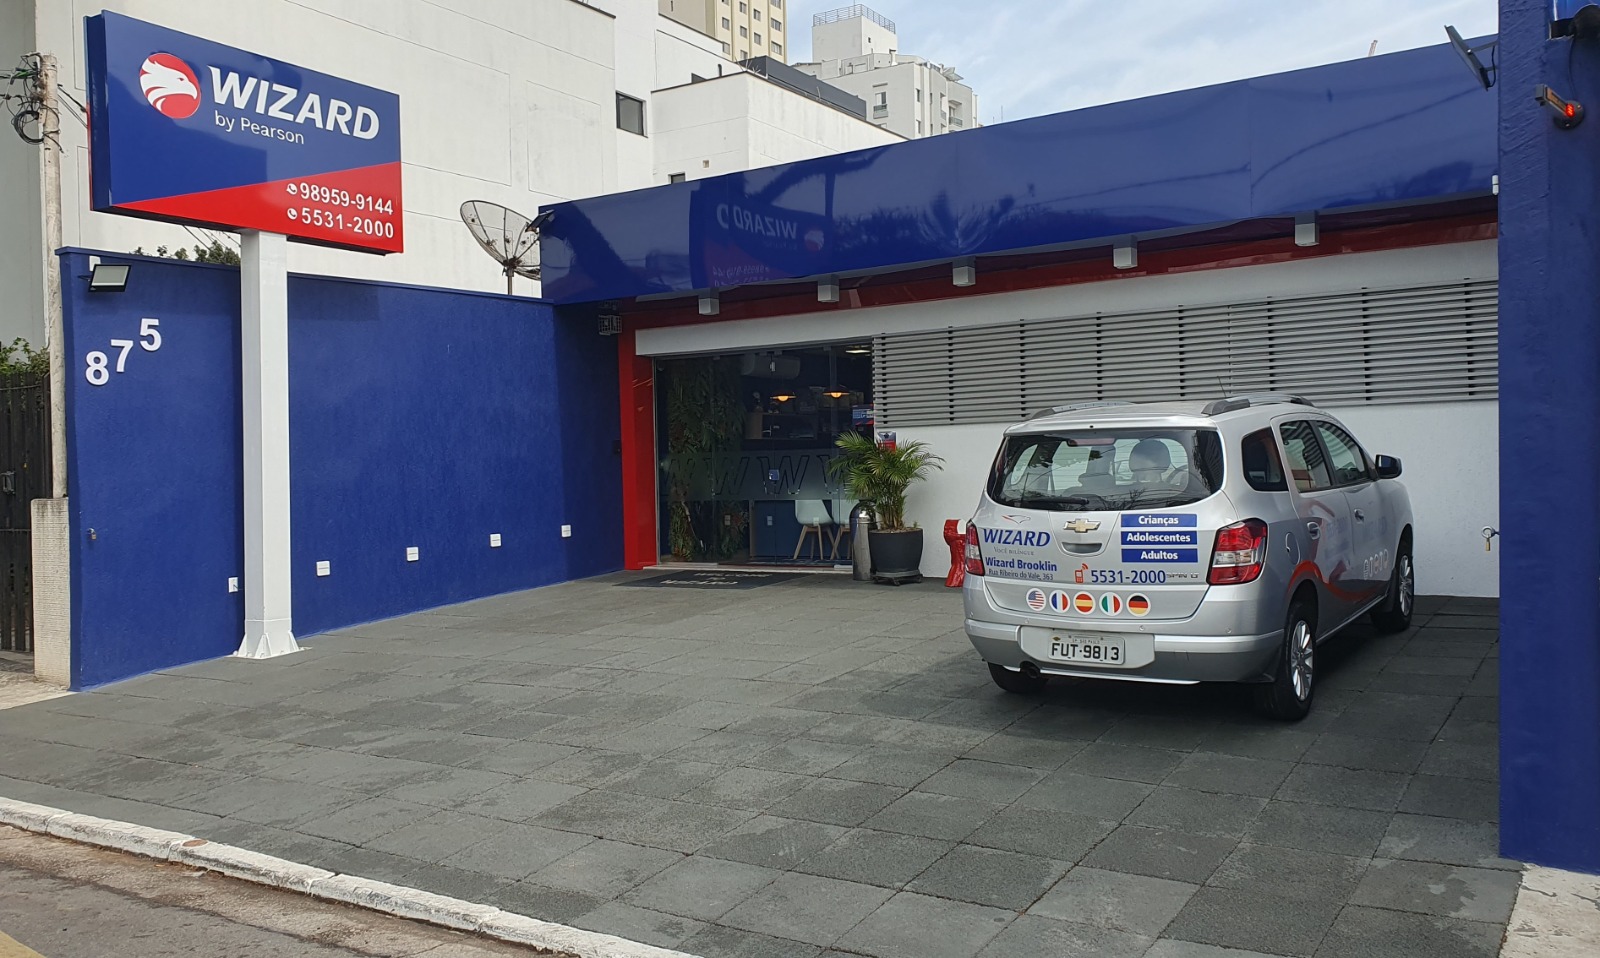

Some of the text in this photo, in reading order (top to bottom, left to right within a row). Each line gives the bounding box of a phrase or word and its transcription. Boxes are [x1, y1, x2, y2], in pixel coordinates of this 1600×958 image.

[207, 65, 380, 140] WIZARD
[214, 110, 305, 145] by Pearson
[299, 182, 394, 215] 98959-9144
[301, 207, 395, 238] 5531-2000
[1138, 515, 1179, 526] Crianças
[983, 528, 1051, 547] WIZARD
[1126, 532, 1191, 542] Adolescentes
[1140, 551, 1178, 560] Adultos
[985, 556, 1057, 572] Wizard Brooklin
[1000, 569, 1018, 577] Ribeiro
[1042, 573, 1054, 581] 363
[1091, 570, 1167, 583] 5531-2000
